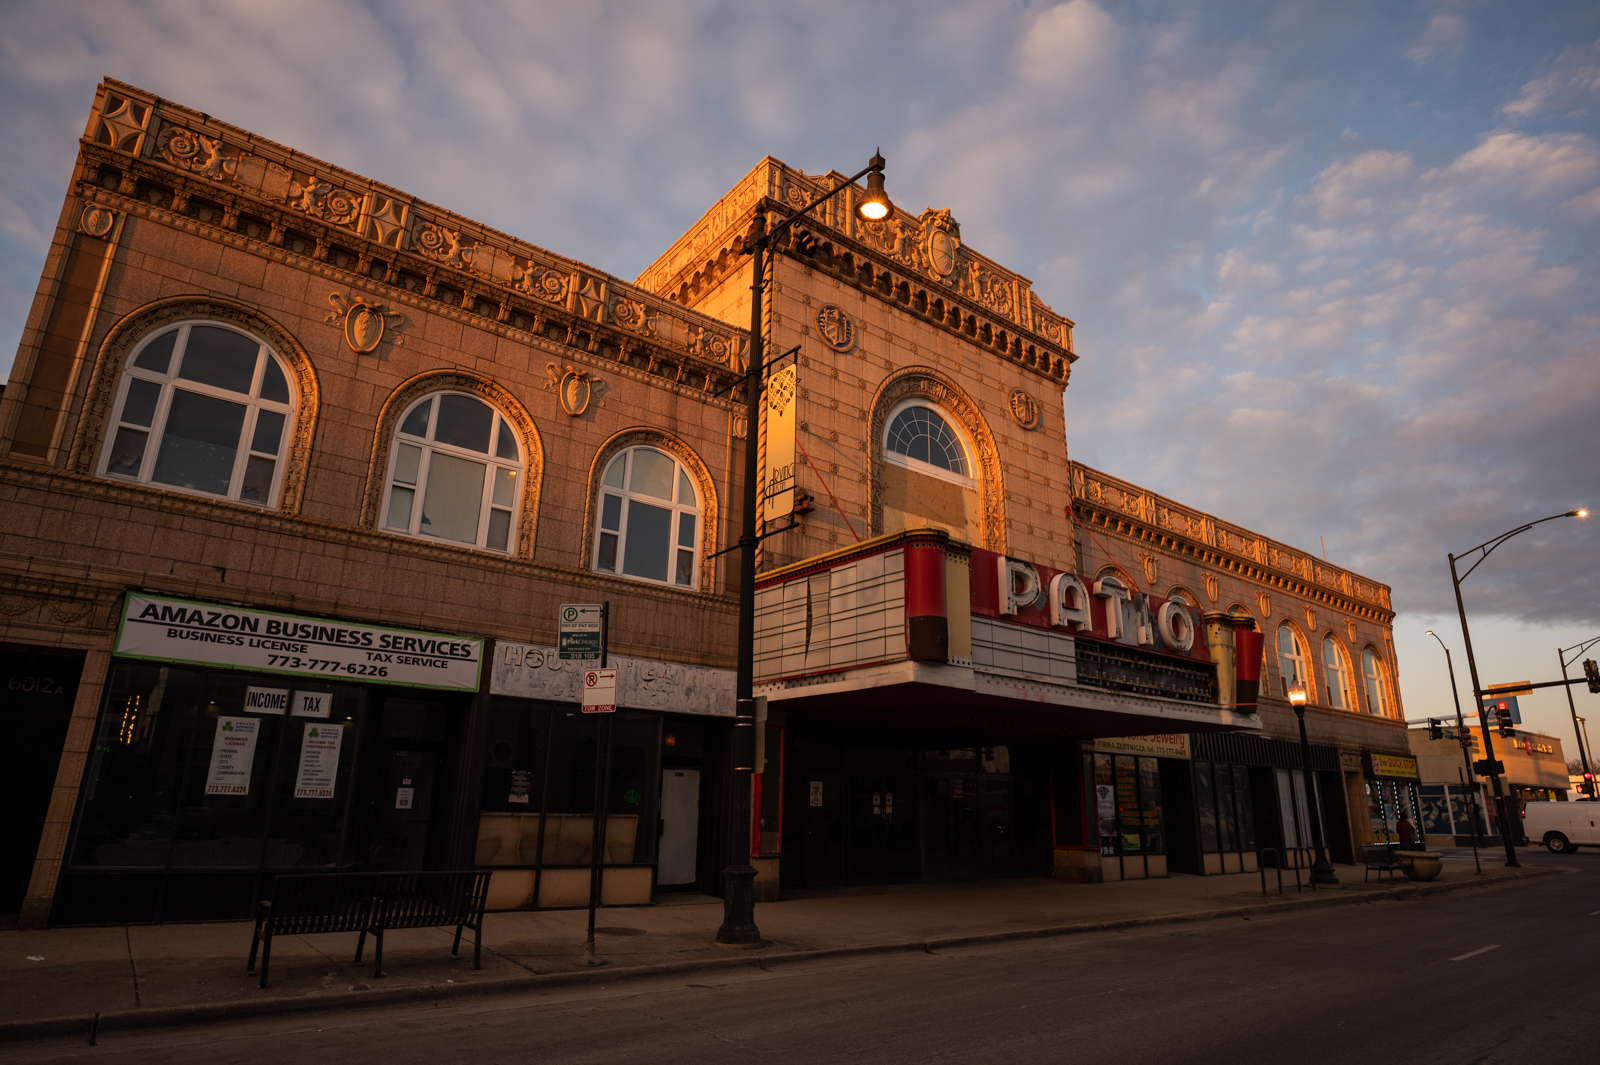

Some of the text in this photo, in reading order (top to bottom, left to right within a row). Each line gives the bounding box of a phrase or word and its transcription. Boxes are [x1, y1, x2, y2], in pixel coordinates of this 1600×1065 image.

[997, 555, 1194, 652] PATIO
[139, 603, 471, 658] AMAZON BUSINESS SERVICES
[166, 628, 308, 654] BUSINESS LICENSE
[567, 637, 598, 645] ParkChicago
[267, 654, 388, 677] 773-777-6226
[366, 652, 449, 669] TAX SERVICE
[247, 692, 287, 709] INCOME
[303, 696, 321, 712] TAX
[1097, 741, 1115, 749] FIRMA
[1388, 757, 1403, 768] QUICK
[1403, 759, 1415, 770] STOP
[207, 785, 247, 793] 773.777.6226
[296, 789, 332, 797] 773.777.6226
